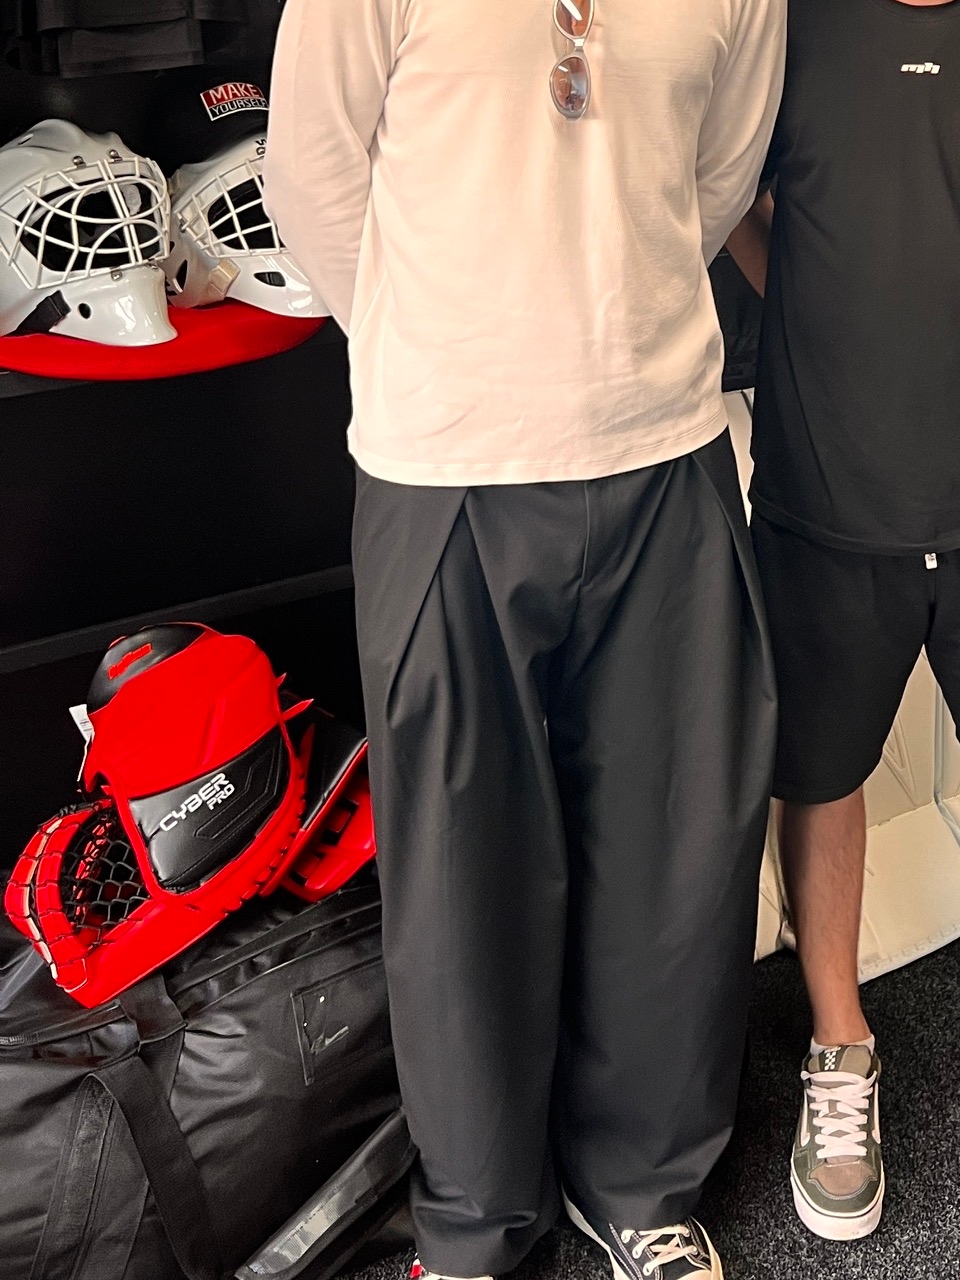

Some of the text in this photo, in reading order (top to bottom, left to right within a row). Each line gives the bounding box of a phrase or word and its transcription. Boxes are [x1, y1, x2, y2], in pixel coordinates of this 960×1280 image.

[208, 83, 260, 104] MAKE
[211, 99, 267, 116] YOURSELF
[159, 772, 230, 832] CYBER
[206, 783, 235, 811] PRO
